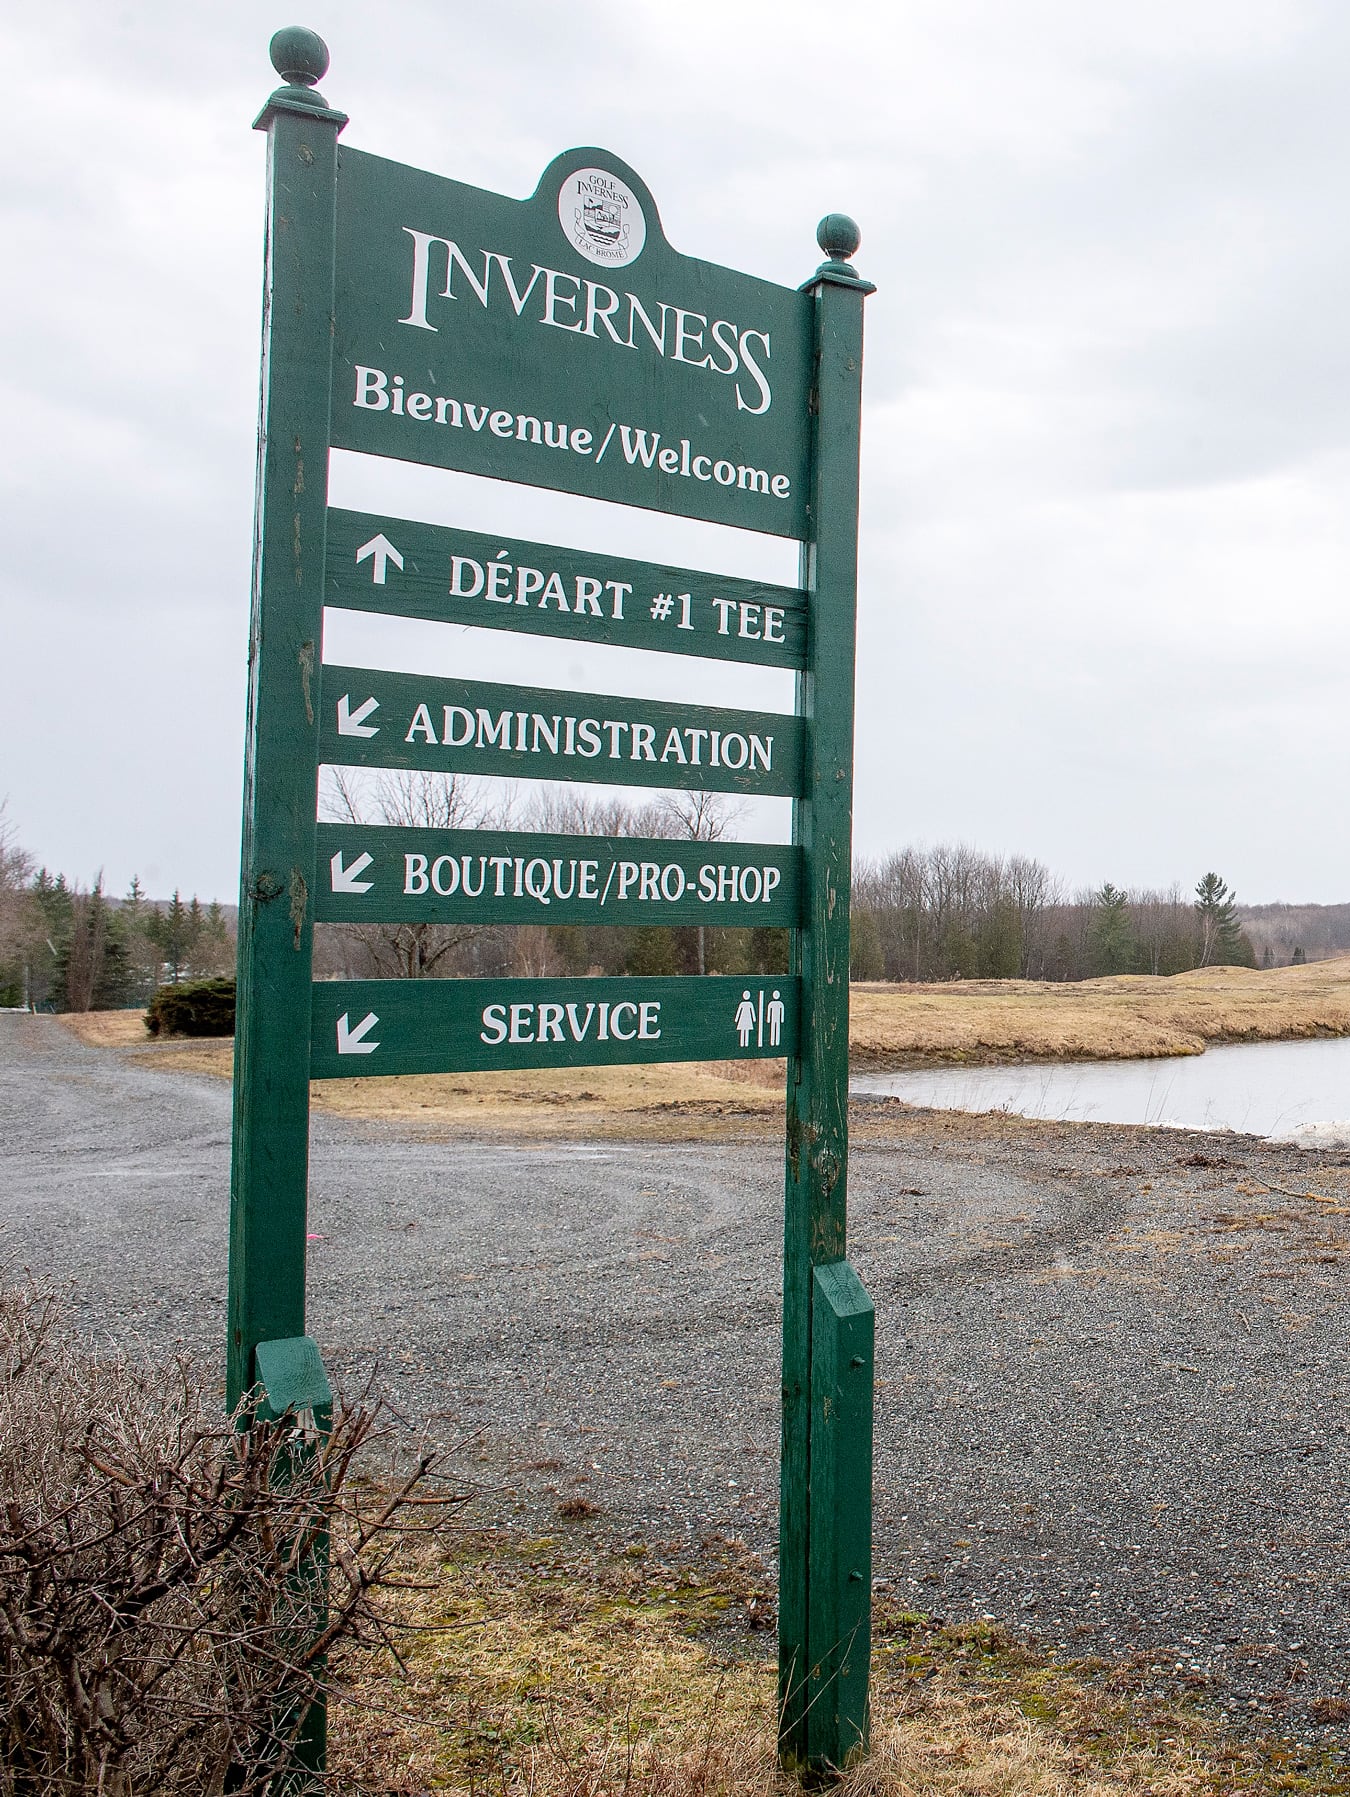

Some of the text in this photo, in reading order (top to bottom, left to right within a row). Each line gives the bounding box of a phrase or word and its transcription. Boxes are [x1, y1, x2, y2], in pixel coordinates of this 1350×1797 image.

[577, 180, 629, 209] INVERNESS
[589, 175, 616, 190] GOLF
[578, 239, 596, 252] LAC
[398, 226, 772, 415] INVERNESS
[353, 364, 790, 499] Bienvenue/Welcome
[449, 551, 786, 643] DÉPART #1 TEE
[404, 703, 774, 772] ADMINISTRATION
[403, 854, 781, 905] BOUTIQUE/PRO-SHOP
[480, 1002, 662, 1045] SERVICE
